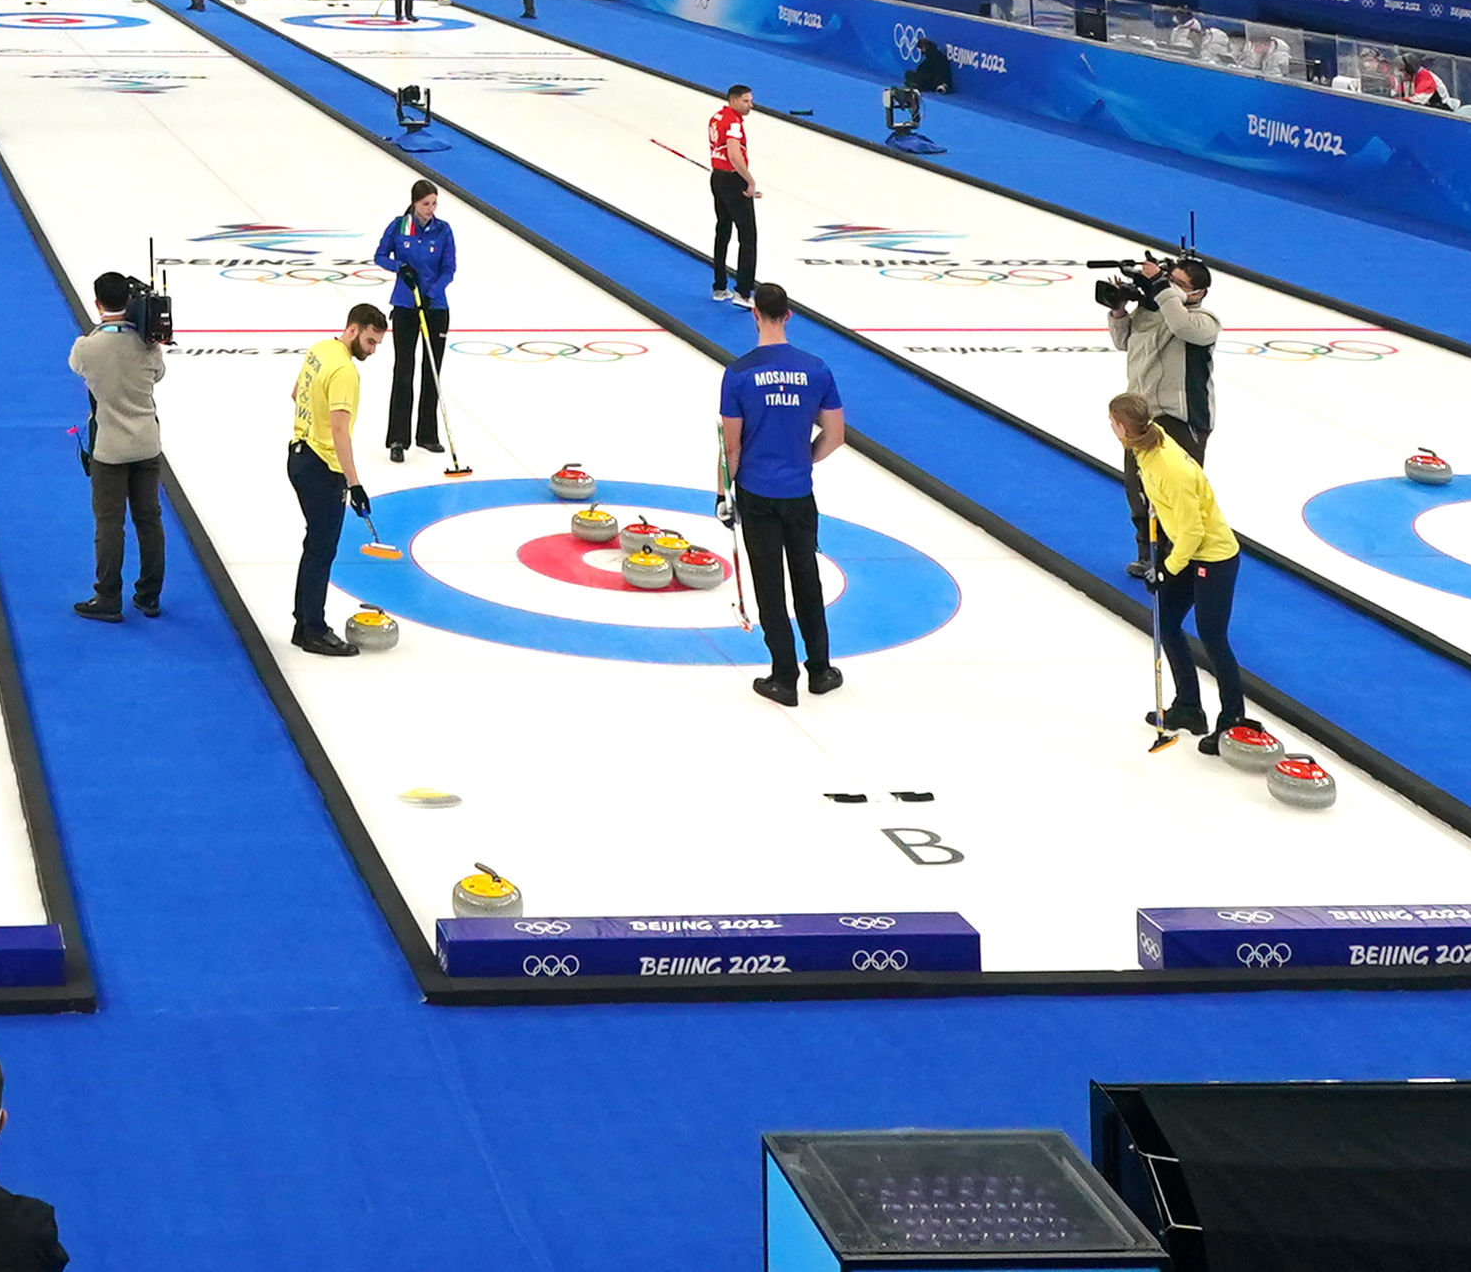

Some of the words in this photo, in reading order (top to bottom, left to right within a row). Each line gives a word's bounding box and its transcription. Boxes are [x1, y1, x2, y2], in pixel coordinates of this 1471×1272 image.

[779, 5, 802, 25] BEIJING
[804, 12, 822, 28] 2022
[946, 44, 978, 68] BEIJING
[981, 53, 1006, 73] 2022
[1247, 114, 1299, 147] BEIJING
[1304, 128, 1346, 155] 2022
[156, 259, 315, 267] BEIJING
[802, 259, 961, 268] BEIJING
[973, 259, 1088, 267] 2022
[166, 348, 260, 357] EIJING
[906, 346, 1023, 354] BEIJING
[755, 371, 807, 387] MOSANER
[765, 393, 799, 407] ITALIA
[881, 828, 964, 865] B
[1329, 910, 1412, 923] BEIJING
[630, 920, 712, 934] BEIJING
[718, 920, 783, 930] 2022
[1349, 945, 1428, 965] BEIJING
[640, 957, 721, 975] BEIJING
[729, 955, 791, 974] 2022
